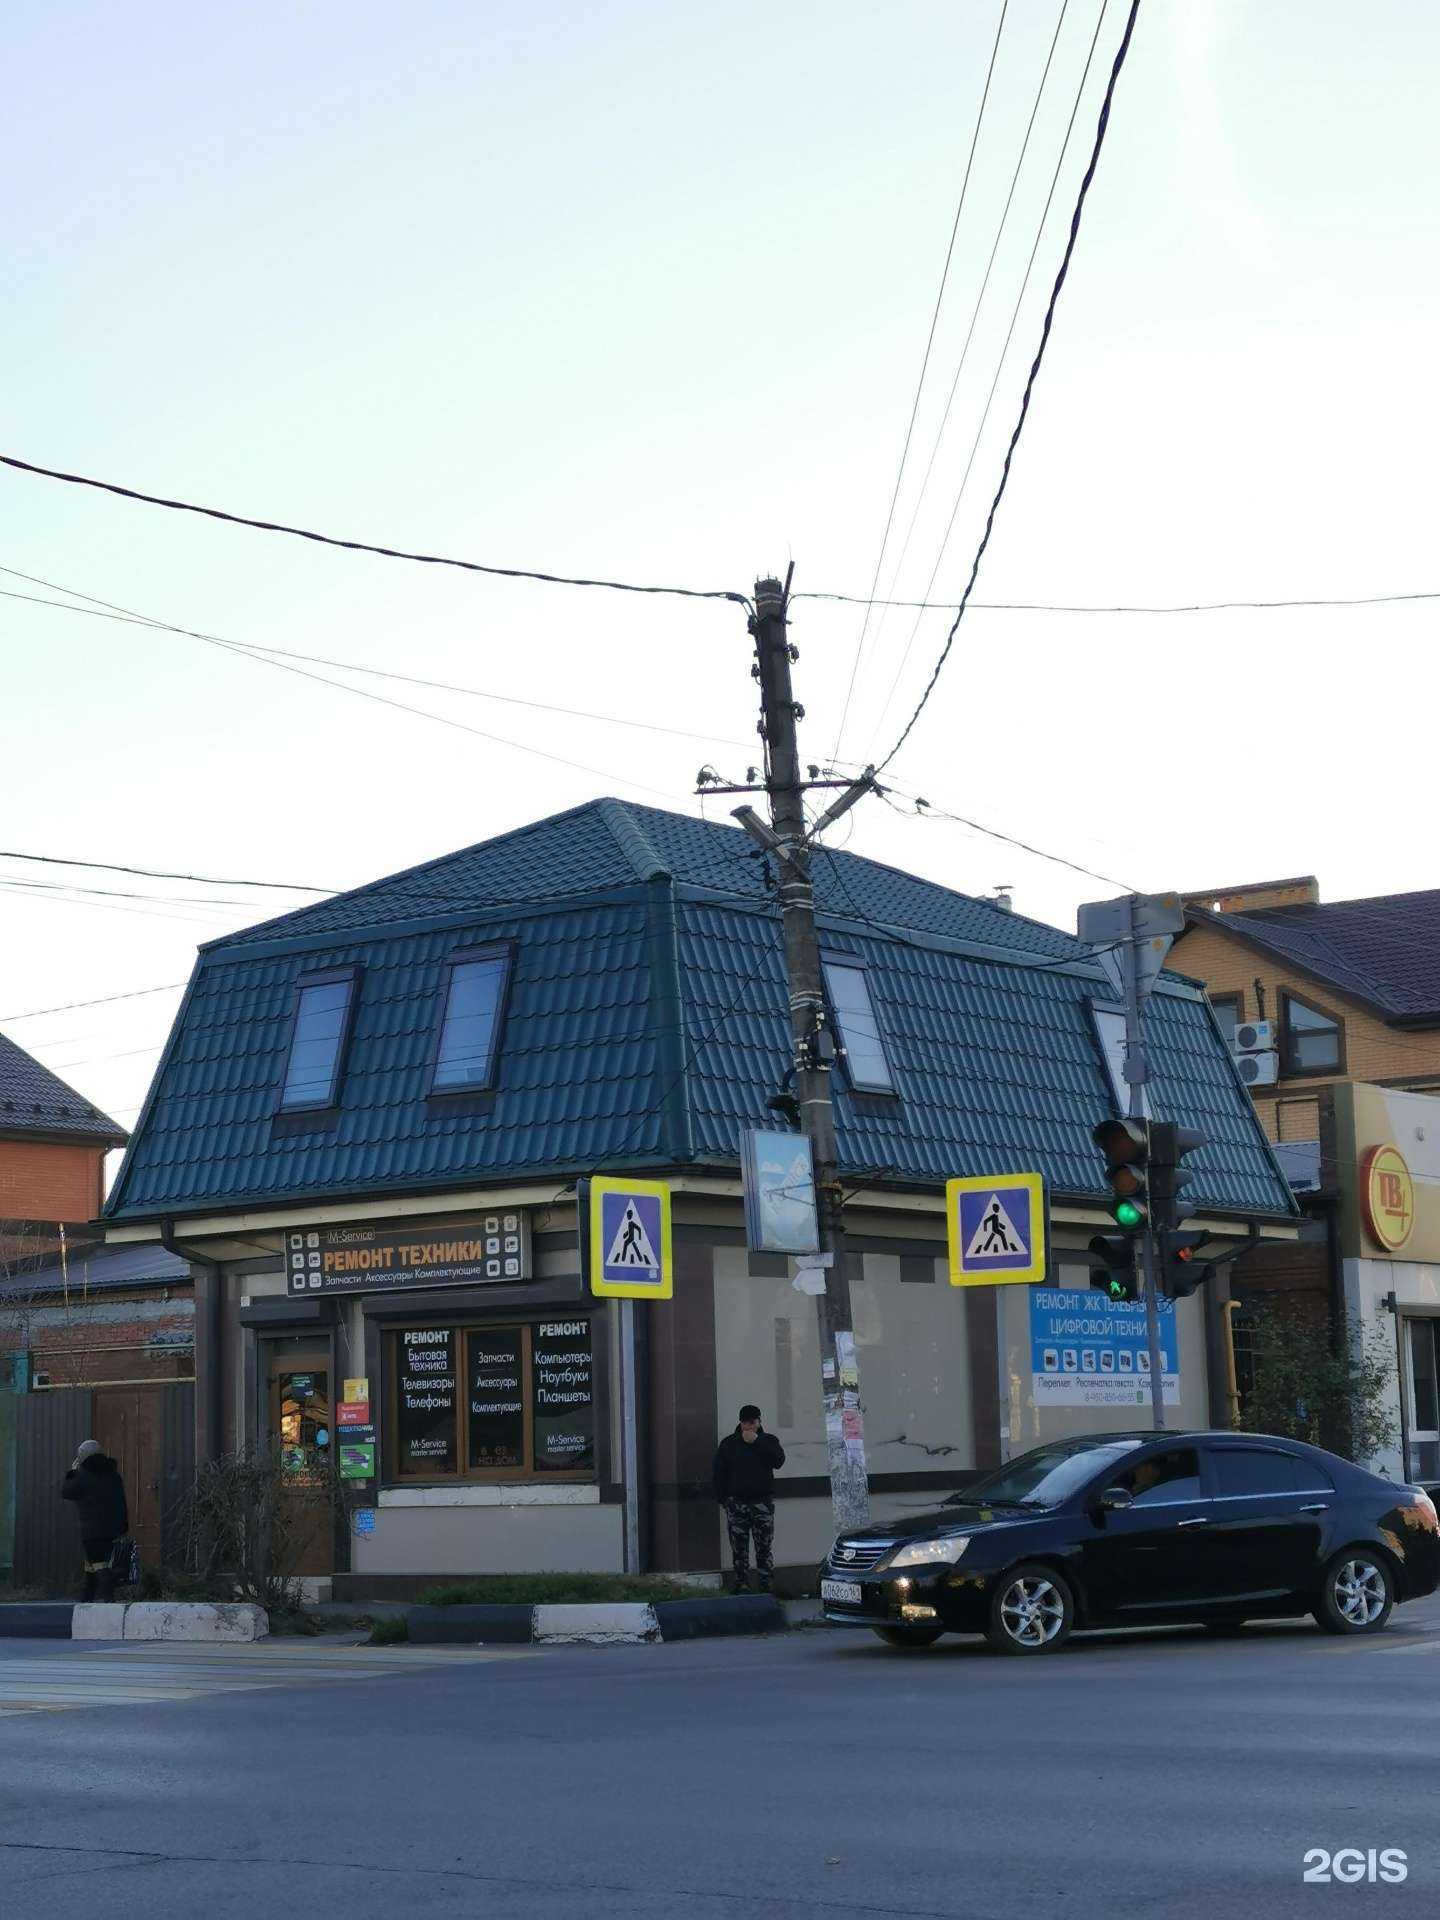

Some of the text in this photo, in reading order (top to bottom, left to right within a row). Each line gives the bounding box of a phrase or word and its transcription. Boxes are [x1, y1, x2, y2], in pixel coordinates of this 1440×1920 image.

[328, 1230, 374, 1243] M-Service
[324, 1240, 482, 1271] РЕМОНТ ТЕХНИКИ
[325, 1265, 481, 1286] Запчасти Аксессуары Комплектующие
[1035, 1293, 1080, 1311] РЕМОНТ
[1084, 1296, 1100, 1311] ЖК
[539, 1321, 587, 1337] РЕМОНТ
[1050, 1317, 1161, 1337] ЦИФРОВОЙ ТЕХНИ
[404, 1330, 449, 1344] РЕМОНТ
[408, 1348, 447, 1361] Бытовая
[477, 1352, 515, 1364] Запчасти
[535, 1351, 592, 1366] Компьютеры
[409, 1361, 447, 1371] техника
[402, 1377, 455, 1393] Телевизоры
[476, 1376, 517, 1391] Аксессуары
[540, 1369, 589, 1387] Ноутбуки
[405, 1394, 451, 1412] Телефоны
[538, 1389, 591, 1403] Планшеты
[472, 1400, 522, 1415] Комплектующие
[410, 1438, 447, 1449] M-Service
[547, 1434, 585, 1446] M-Service
